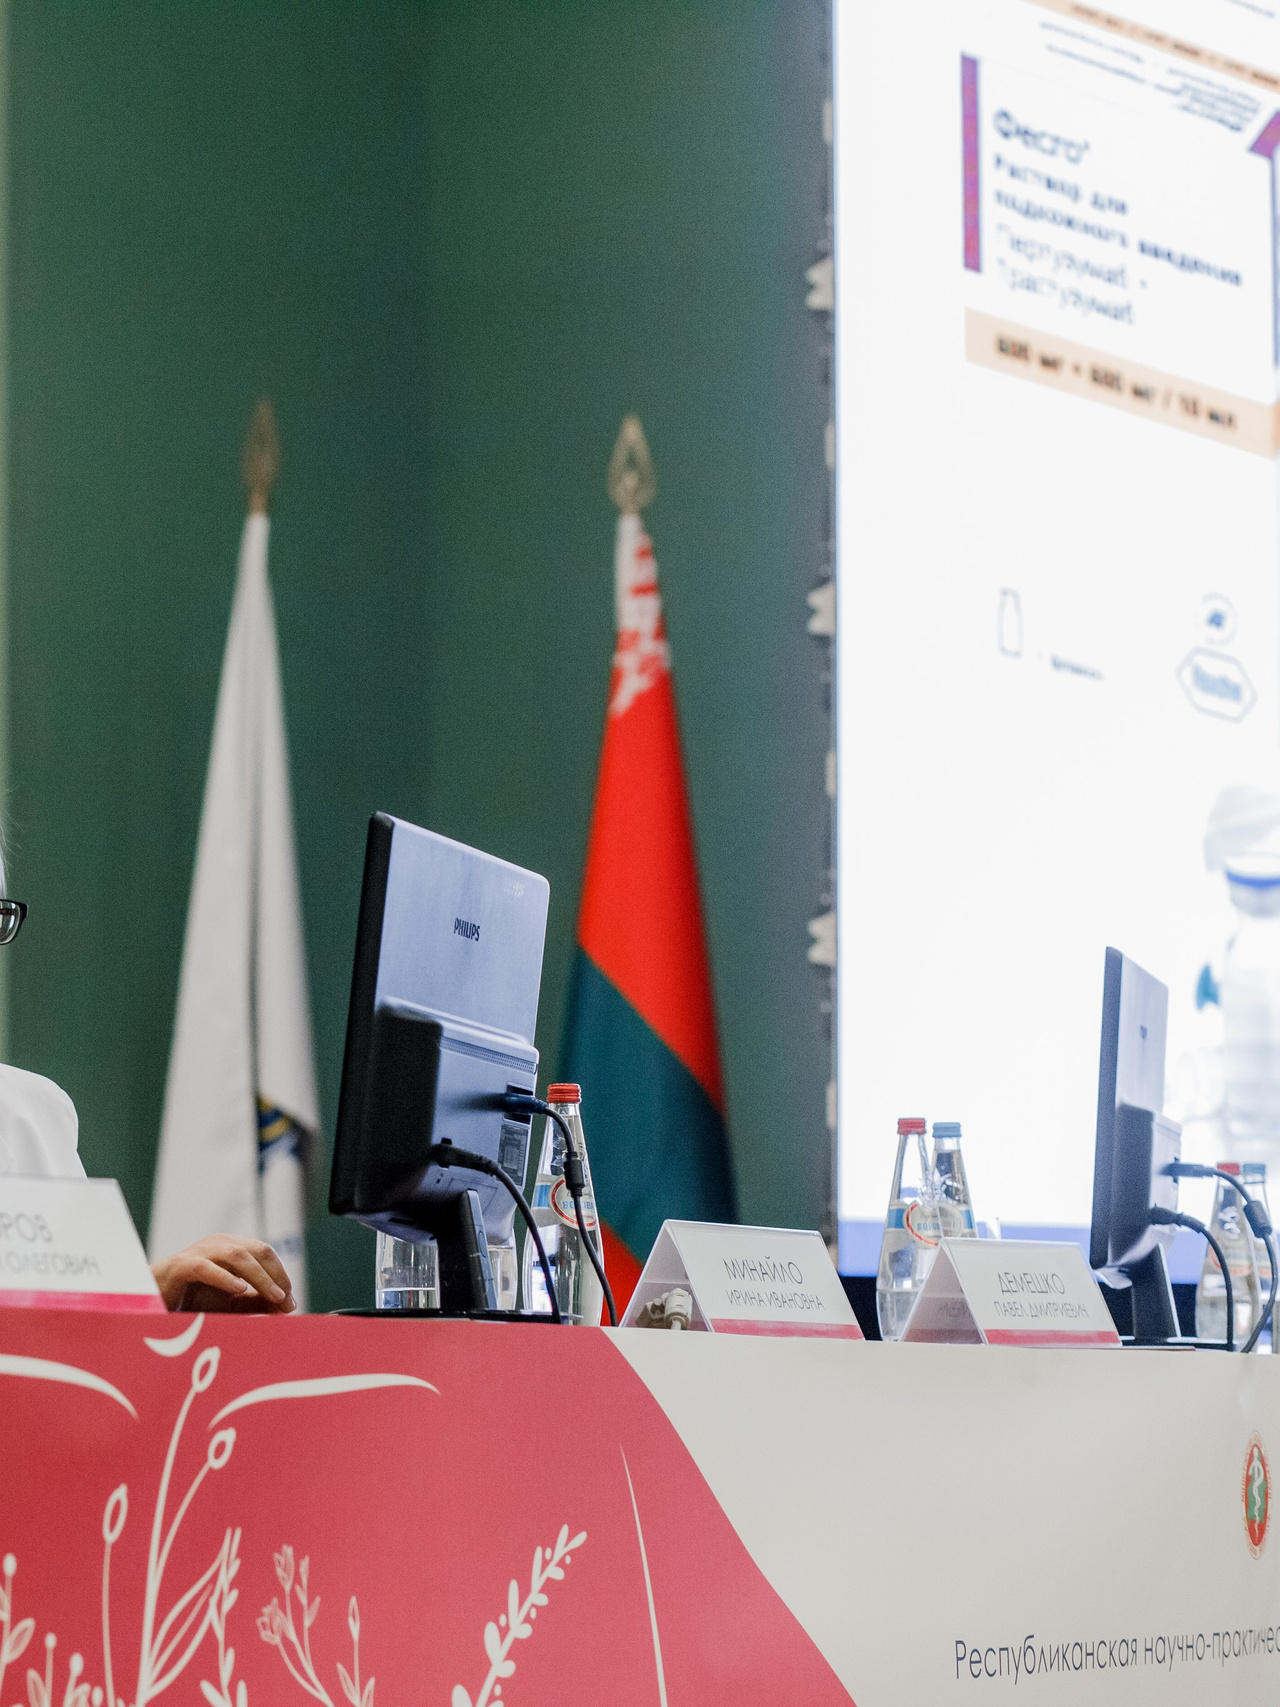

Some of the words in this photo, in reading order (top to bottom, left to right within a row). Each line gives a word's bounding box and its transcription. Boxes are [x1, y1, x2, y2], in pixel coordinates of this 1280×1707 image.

[453, 917, 480, 942] PHILIPS
[722, 1255, 804, 1284] МИНАЙЛО
[998, 1272, 1065, 1295] ДЕМЕШКО
[725, 1289, 767, 1307] ИРИНА
[765, 1291, 825, 1310] ИВАНОВНА
[994, 1301, 1028, 1317] ПАВЕЛ
[1028, 1302, 1089, 1319] ДМИТРИЕВИЧ
[955, 1634, 1138, 1685] Республиканская
